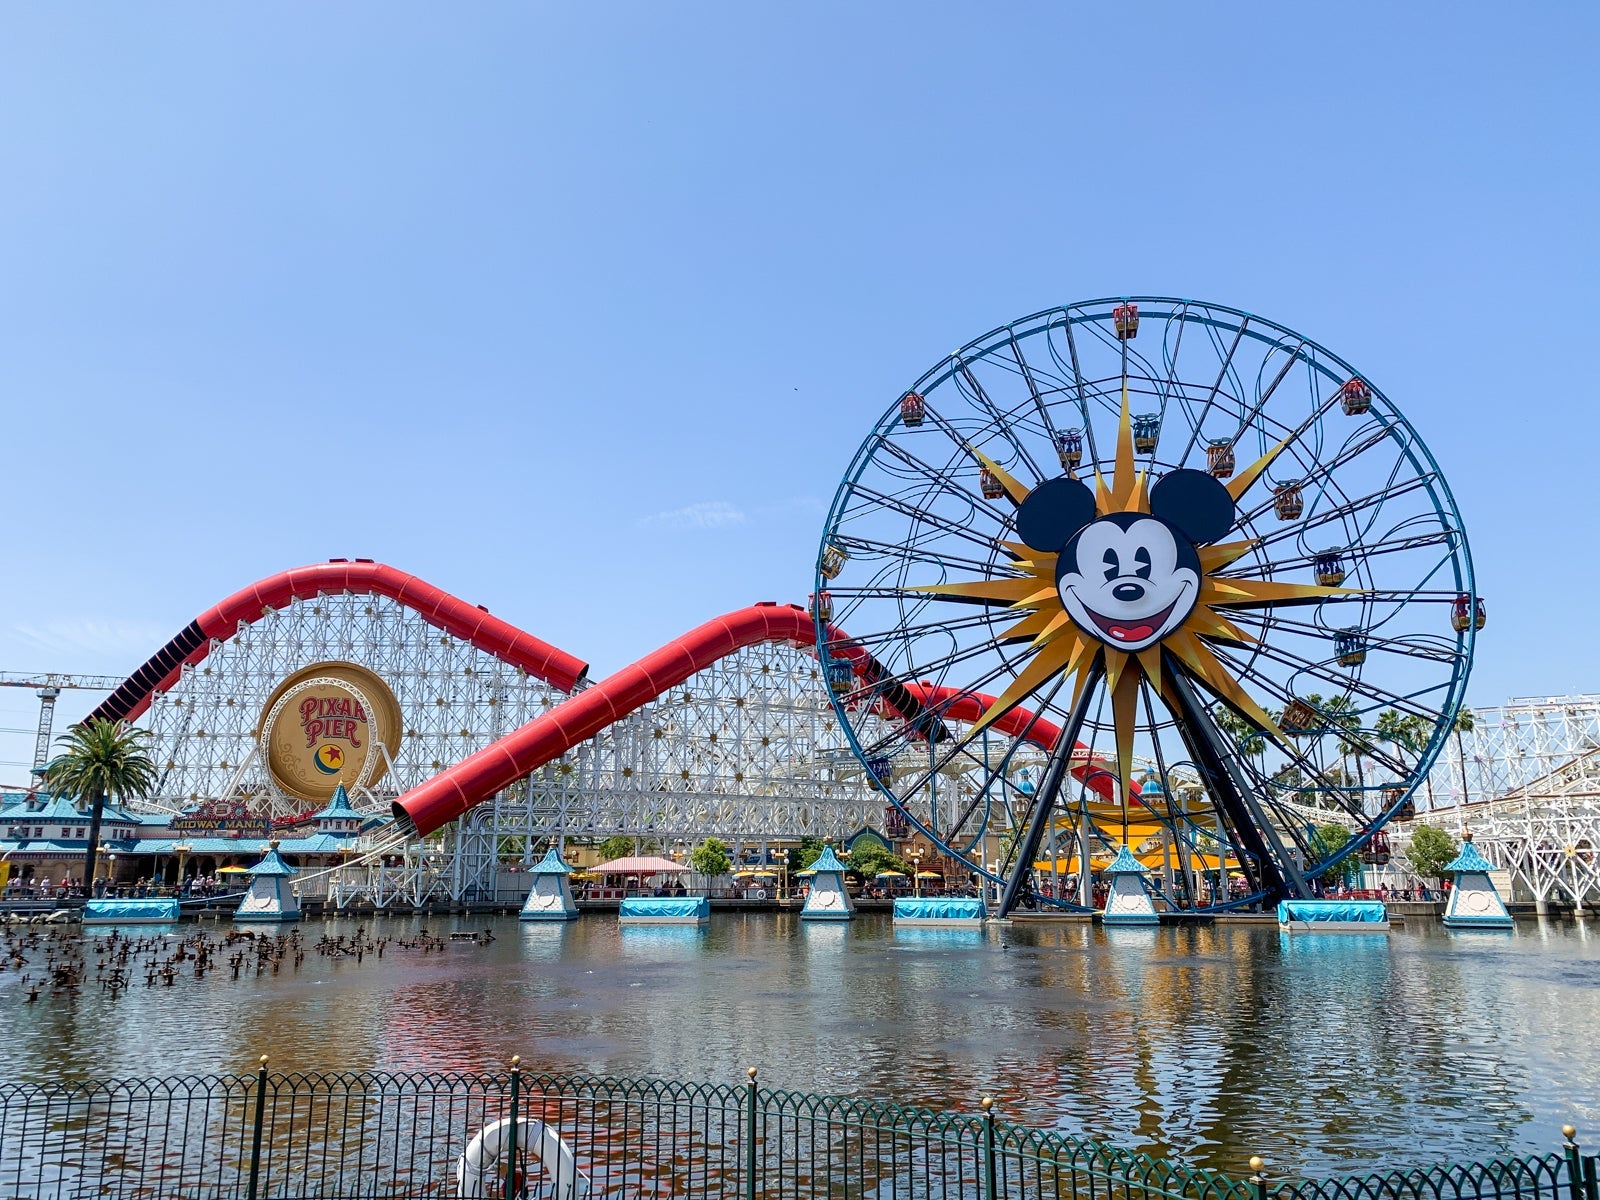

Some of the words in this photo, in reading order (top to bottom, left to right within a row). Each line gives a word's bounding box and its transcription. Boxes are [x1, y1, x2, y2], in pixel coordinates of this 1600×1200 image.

[299, 696, 368, 726] PIXAR
[305, 719, 361, 748] PIER
[174, 820, 222, 829] MIDWAY
[225, 820, 268, 829] MANIA!
